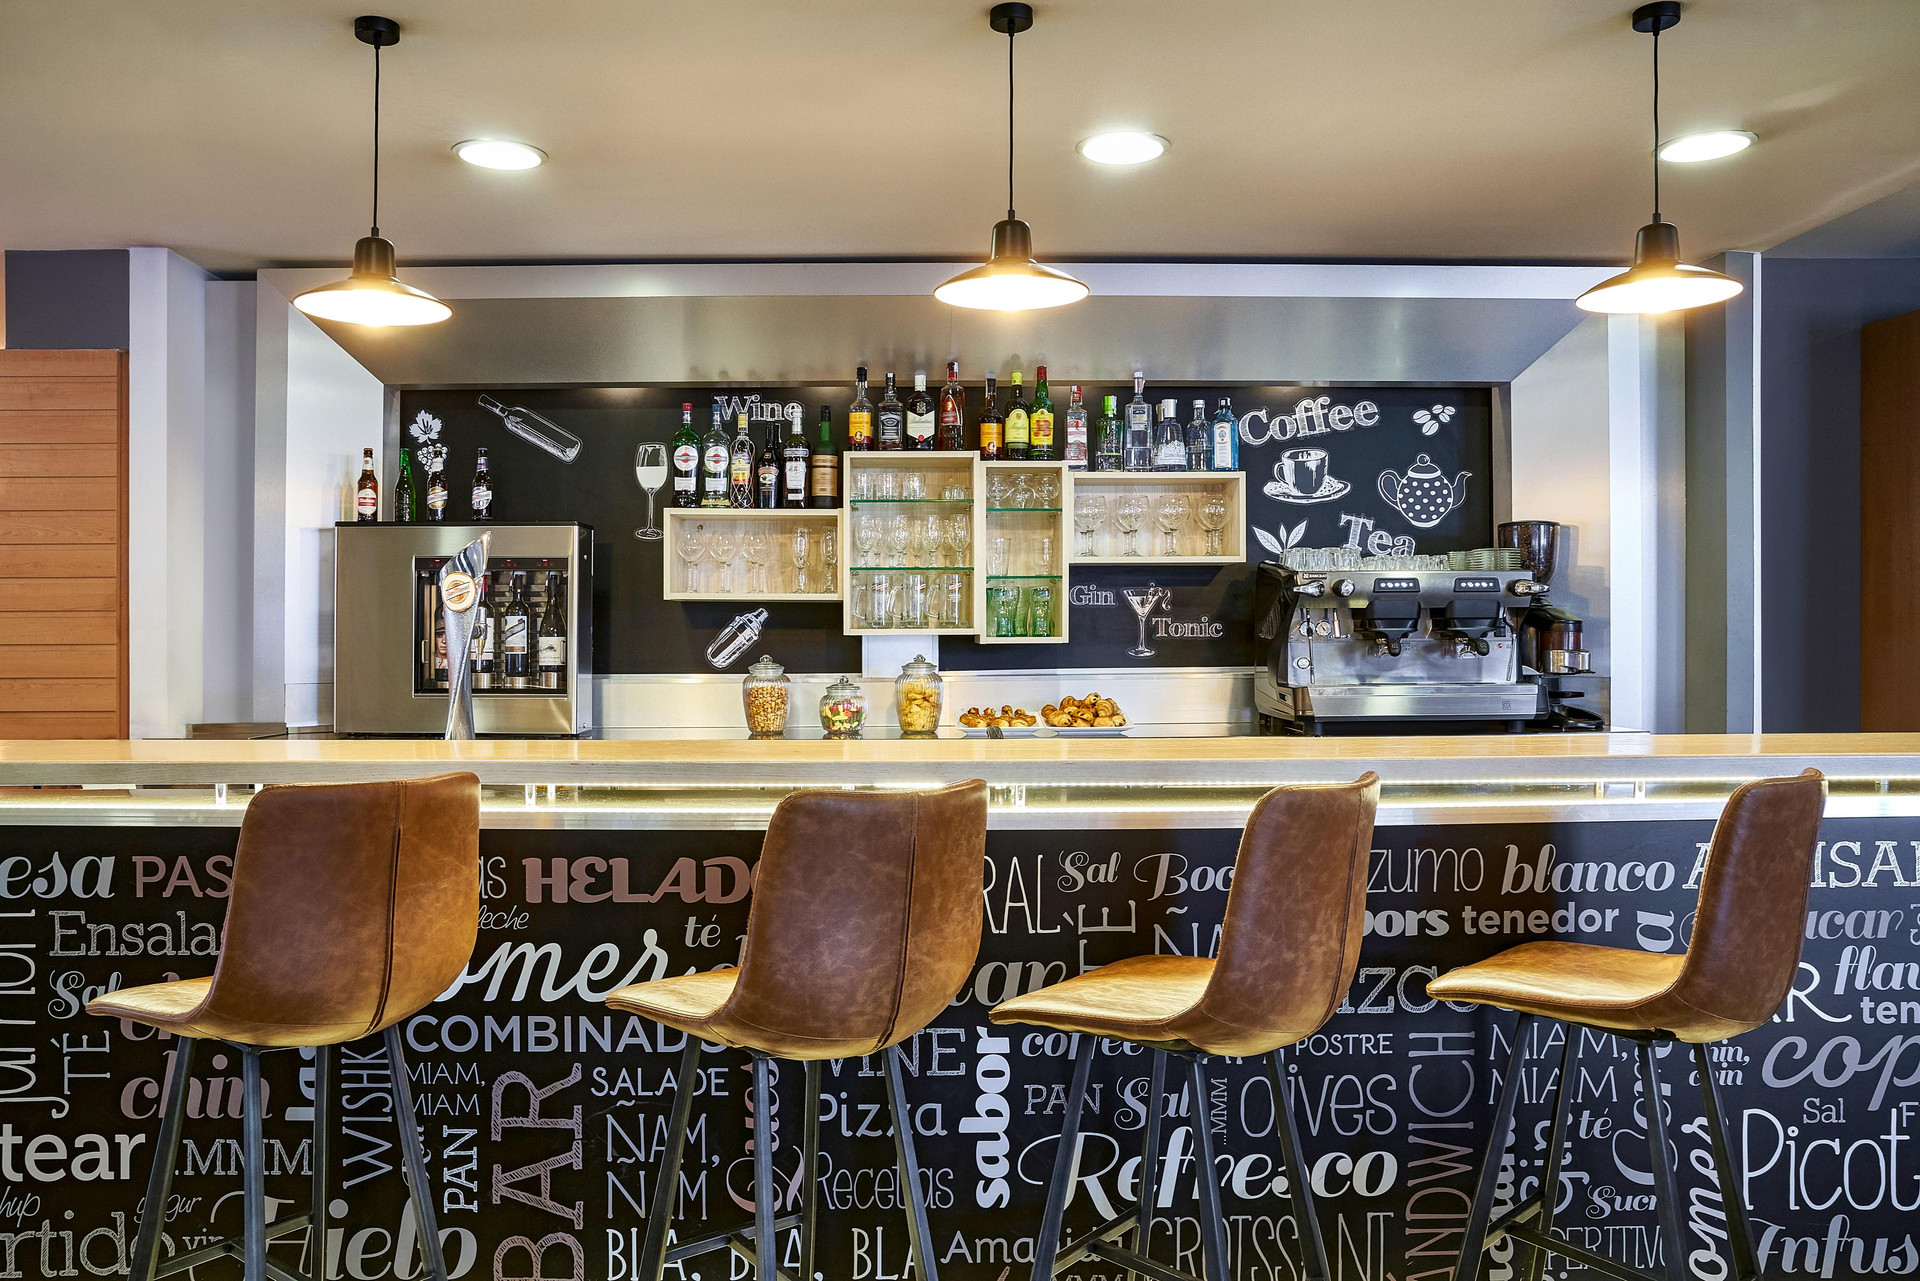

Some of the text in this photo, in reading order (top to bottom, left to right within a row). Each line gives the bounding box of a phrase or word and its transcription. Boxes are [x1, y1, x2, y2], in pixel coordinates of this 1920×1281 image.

[714, 394, 804, 422] Wine
[1238, 396, 1380, 445] Coffee
[1339, 512, 1416, 557] Tea
[1069, 584, 1224, 638] Gin Tonic
[0, 851, 116, 899] esa
[132, 855, 233, 898] PAS
[521, 857, 757, 904] HELAD
[1057, 850, 1122, 893] Sal
[1366, 848, 1484, 893] zumo
[1501, 843, 1675, 895] blanco
[684, 914, 721, 948] té
[1461, 902, 1619, 936] tenedor
[48, 969, 122, 1019] Sal
[803, 1027, 966, 1078] NE
[1021, 1032, 1144, 1060] cofee
[1295, 1033, 1394, 1057] POSTRE
[1489, 1022, 1628, 1062] MIAM,
[120, 1050, 272, 1120] chin
[405, 1062, 486, 1087] MIAM,
[1488, 1065, 1618, 1105] MIAM
[1688, 1061, 1744, 1086] cin
[1761, 1034, 1920, 1111] cop
[340, 1046, 394, 1190] WISHK
[413, 1093, 481, 1116] MIAM
[958, 1025, 1011, 1209] sabor
[1023, 1083, 1104, 1115] PAN
[1114, 1076, 1191, 1131] Sal
[1240, 1063, 1398, 1138] Oives
[1803, 1097, 1847, 1124] Sal
[606, 1099, 721, 1168] ÑAM,
[1579, 1107, 1613, 1140] té
[0, 1124, 146, 1182] tear
[443, 1124, 478, 1214] PAN
[491, 1062, 585, 1281] BAR
[1742, 1108, 1920, 1211] Picot
[606, 1152, 709, 1221] ÑM
